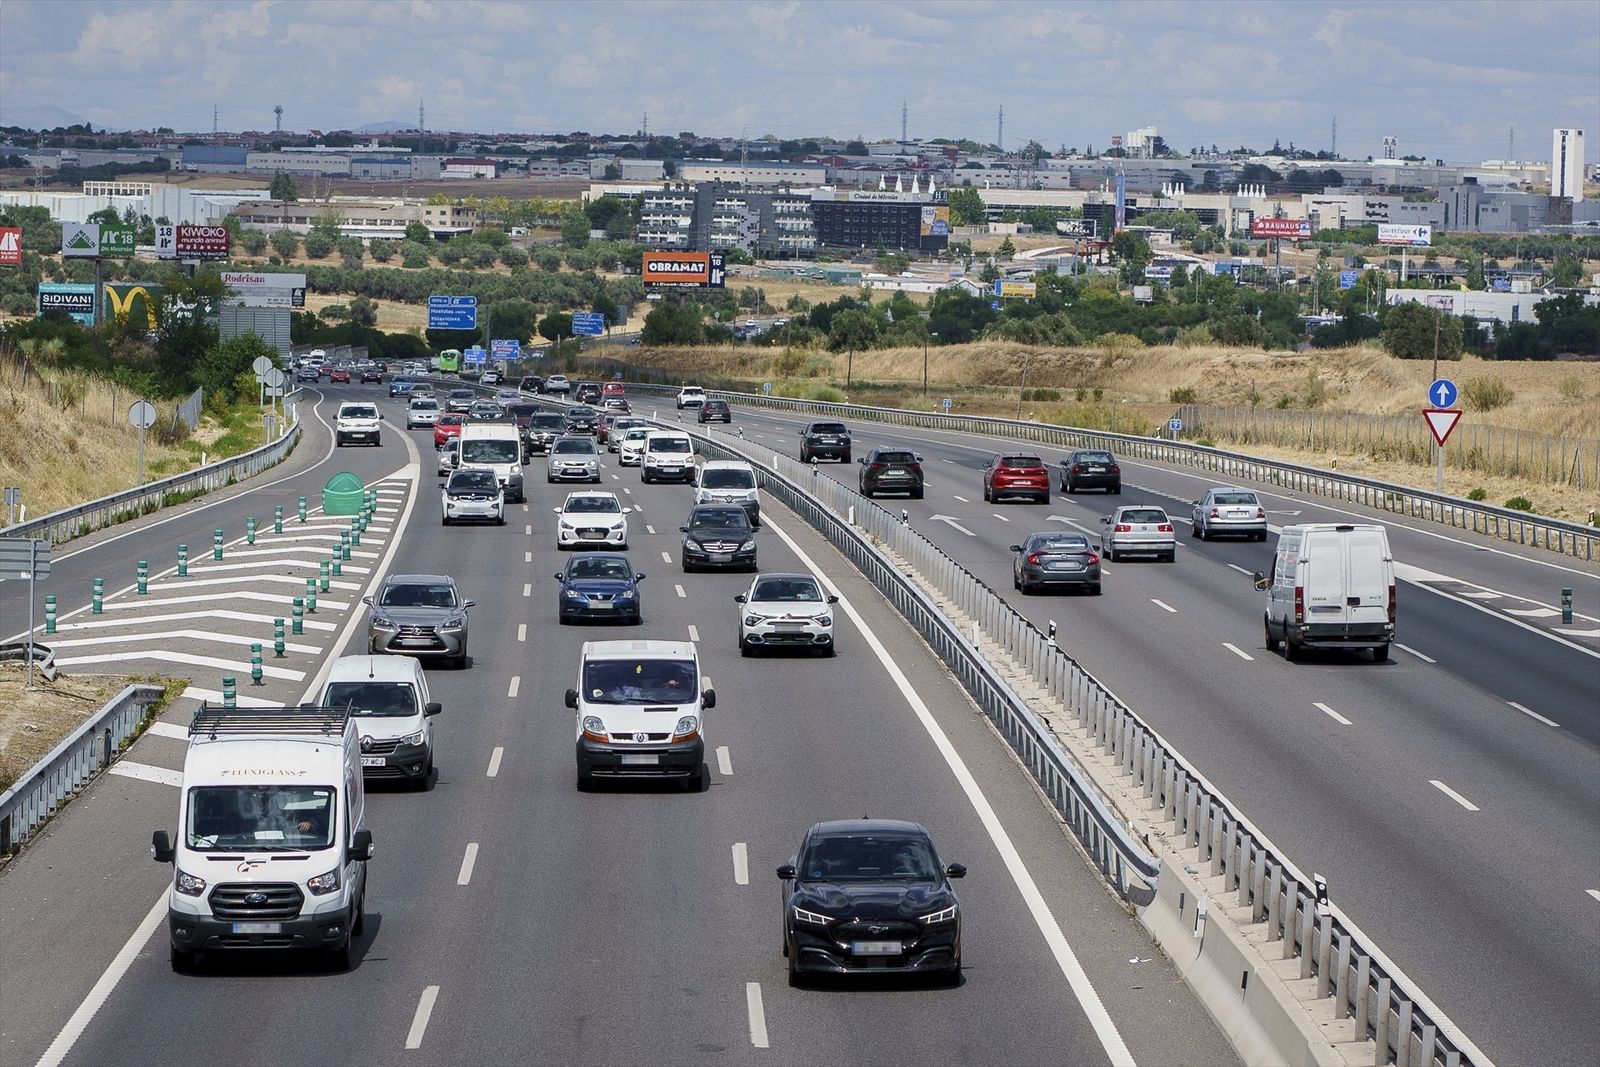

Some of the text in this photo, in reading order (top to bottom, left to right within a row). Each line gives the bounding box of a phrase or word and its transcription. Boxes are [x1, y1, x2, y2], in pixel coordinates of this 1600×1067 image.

[160, 227, 172, 236] 18
[181, 227, 226, 237] KIWOKO
[121, 235, 134, 244] 18
[648, 262, 704, 272] OBRAMAT
[224, 274, 265, 283] Rodrisan
[42, 294, 92, 304] SIDIVANI
